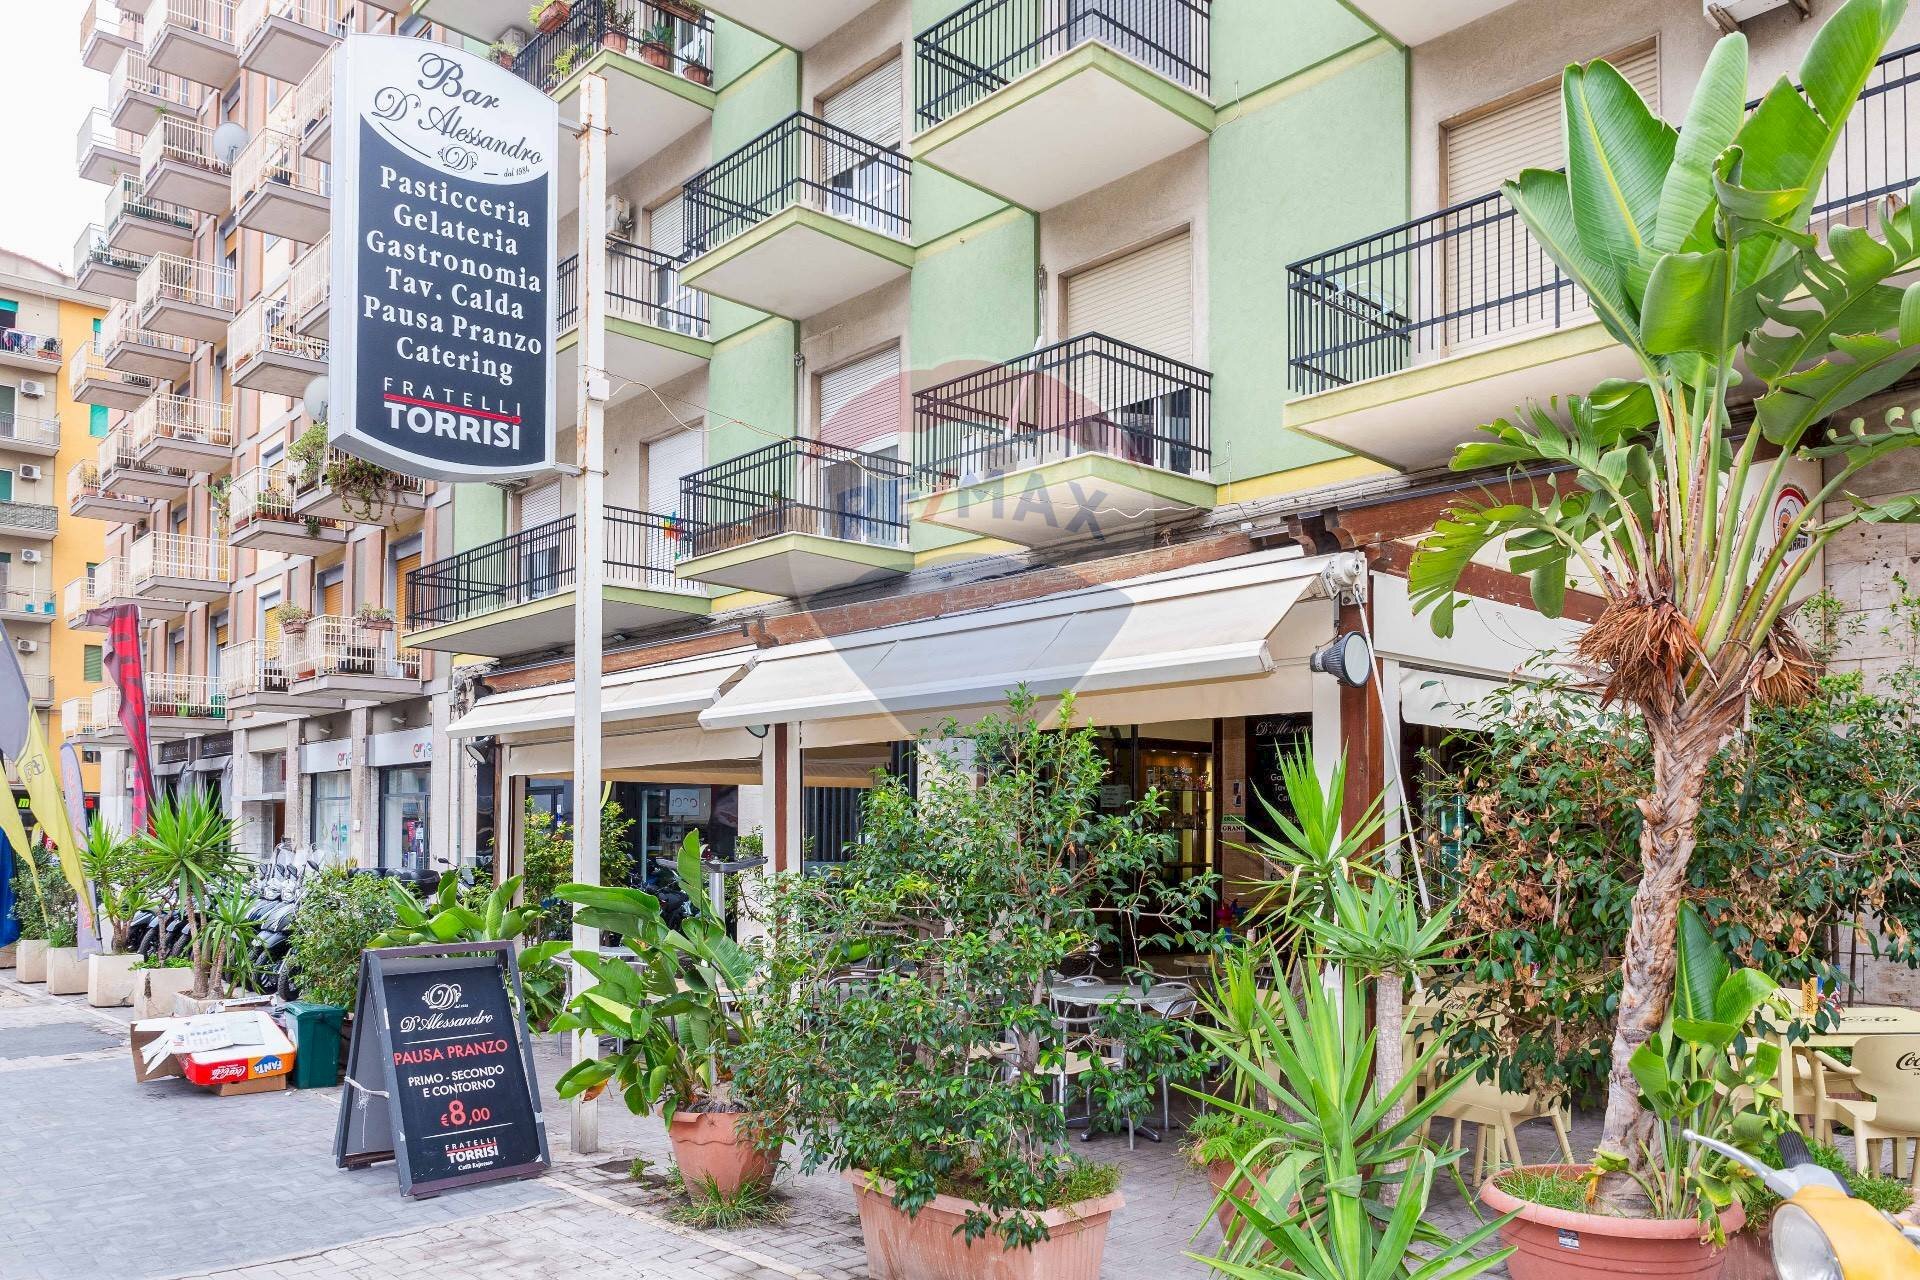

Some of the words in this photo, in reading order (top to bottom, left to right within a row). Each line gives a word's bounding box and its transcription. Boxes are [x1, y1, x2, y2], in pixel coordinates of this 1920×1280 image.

[418, 53, 500, 109] Bar
[380, 165, 530, 228] Pasticceria
[393, 203, 518, 256] Gelateria
[366, 230, 541, 293] Gastronomia
[385, 266, 442, 300] Tav.
[451, 283, 524, 320] Calda
[363, 295, 444, 333] Pausa
[452, 314, 542, 355] Pranzo
[396, 336, 513, 386] Catering
[384, 377, 521, 417] FRATELLI
[383, 401, 520, 450] TORRISI
[400, 1009, 494, 1033] D'Alessandro
[254, 1060, 283, 1074] FANTA
[393, 1047, 445, 1066] PAUSA
[447, 1039, 509, 1060] PRANZO
[408, 1073, 443, 1087] PRIMO
[451, 1064, 505, 1082] SECONDO
[423, 1088, 430, 1099] E
[432, 1078, 496, 1097] CONTORNO
[445, 1136, 497, 1151] FRATELLI
[447, 1145, 499, 1164] TORRISI
